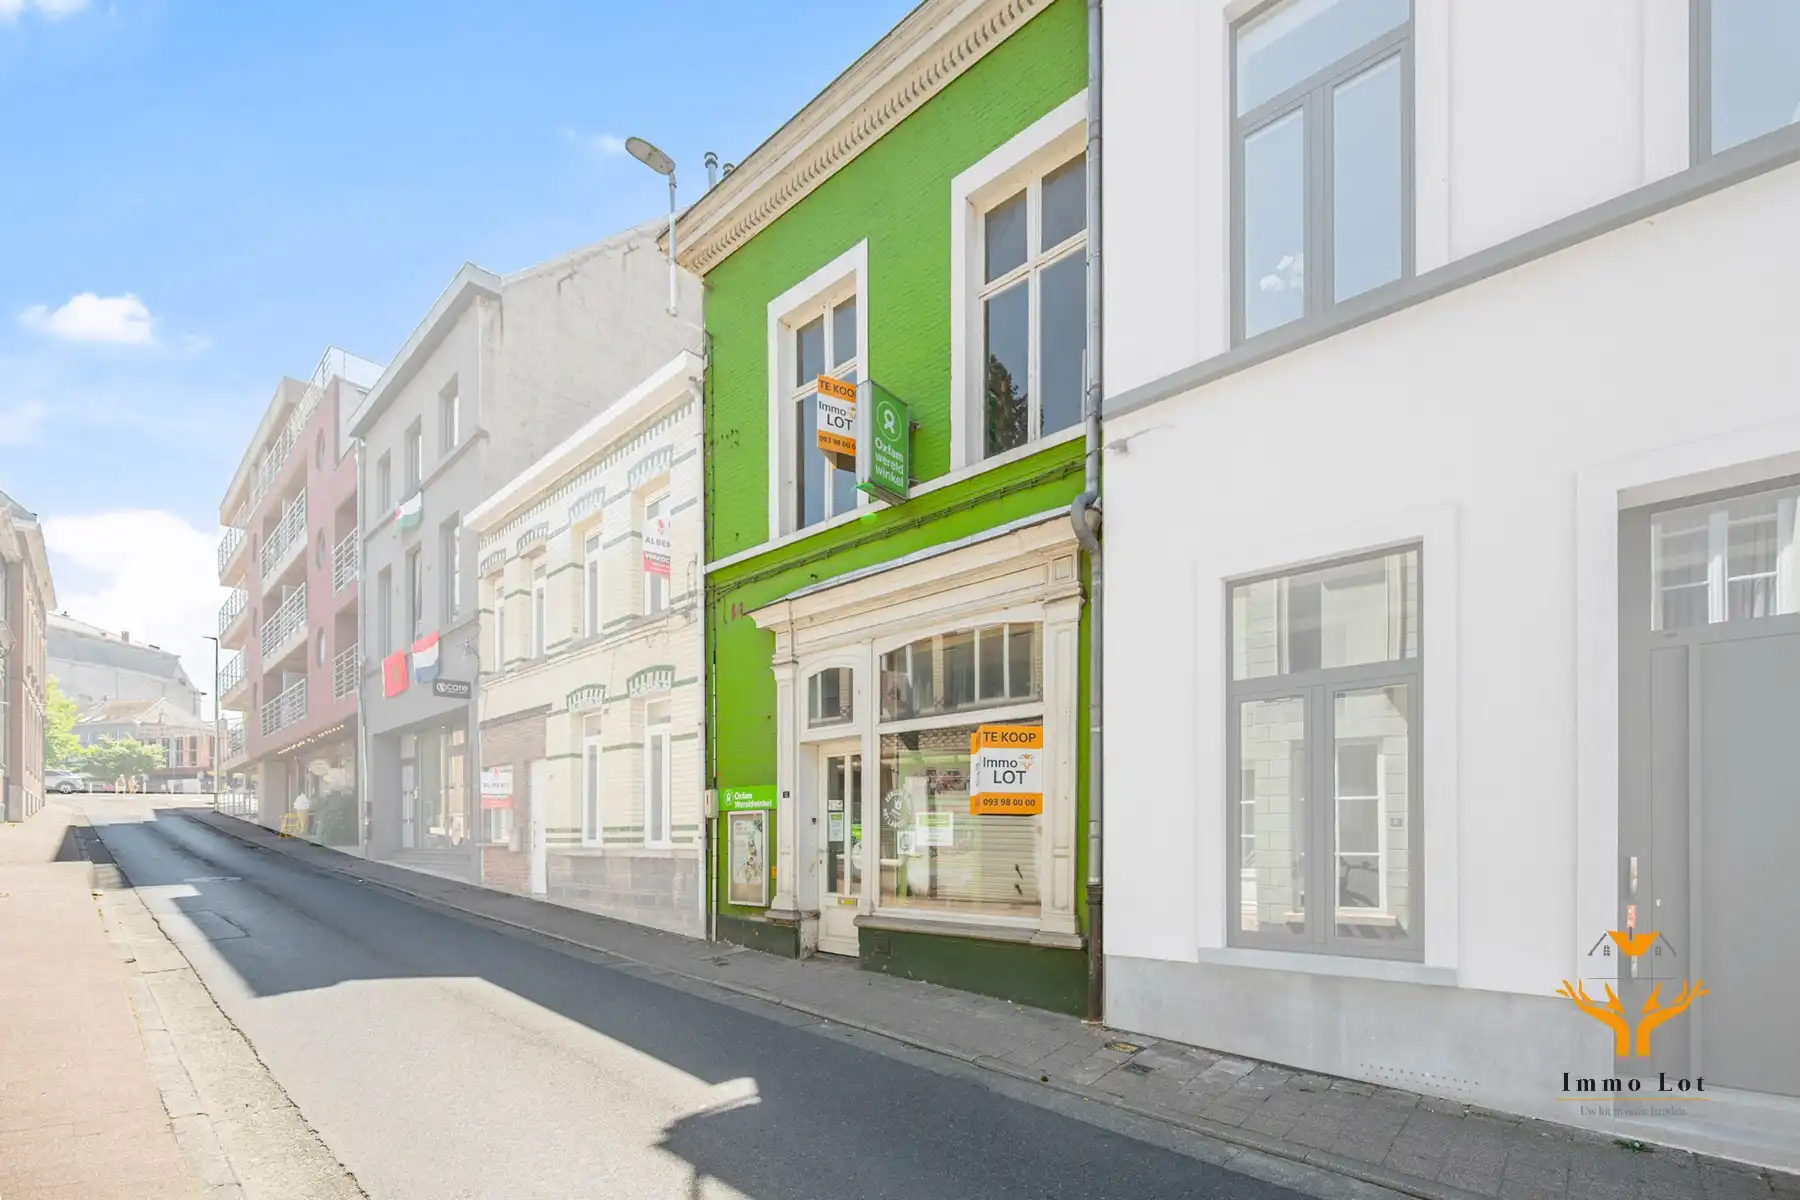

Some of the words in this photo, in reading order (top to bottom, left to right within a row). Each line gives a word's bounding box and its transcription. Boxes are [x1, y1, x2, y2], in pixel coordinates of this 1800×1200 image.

[820, 380, 832, 391] TE
[833, 384, 856, 398] KOO
[819, 400, 847, 416] Immo
[827, 413, 853, 430] LOT
[875, 436, 904, 462] Oxfam
[983, 732, 998, 742] TE
[1001, 732, 1036, 743] KOOP
[983, 757, 1018, 768] Immo
[993, 770, 1027, 784] LOT
[983, 798, 999, 807] 093
[1001, 798, 1011, 807] 98
[1012, 799, 1023, 807] 00
[1025, 799, 1036, 807] 00
